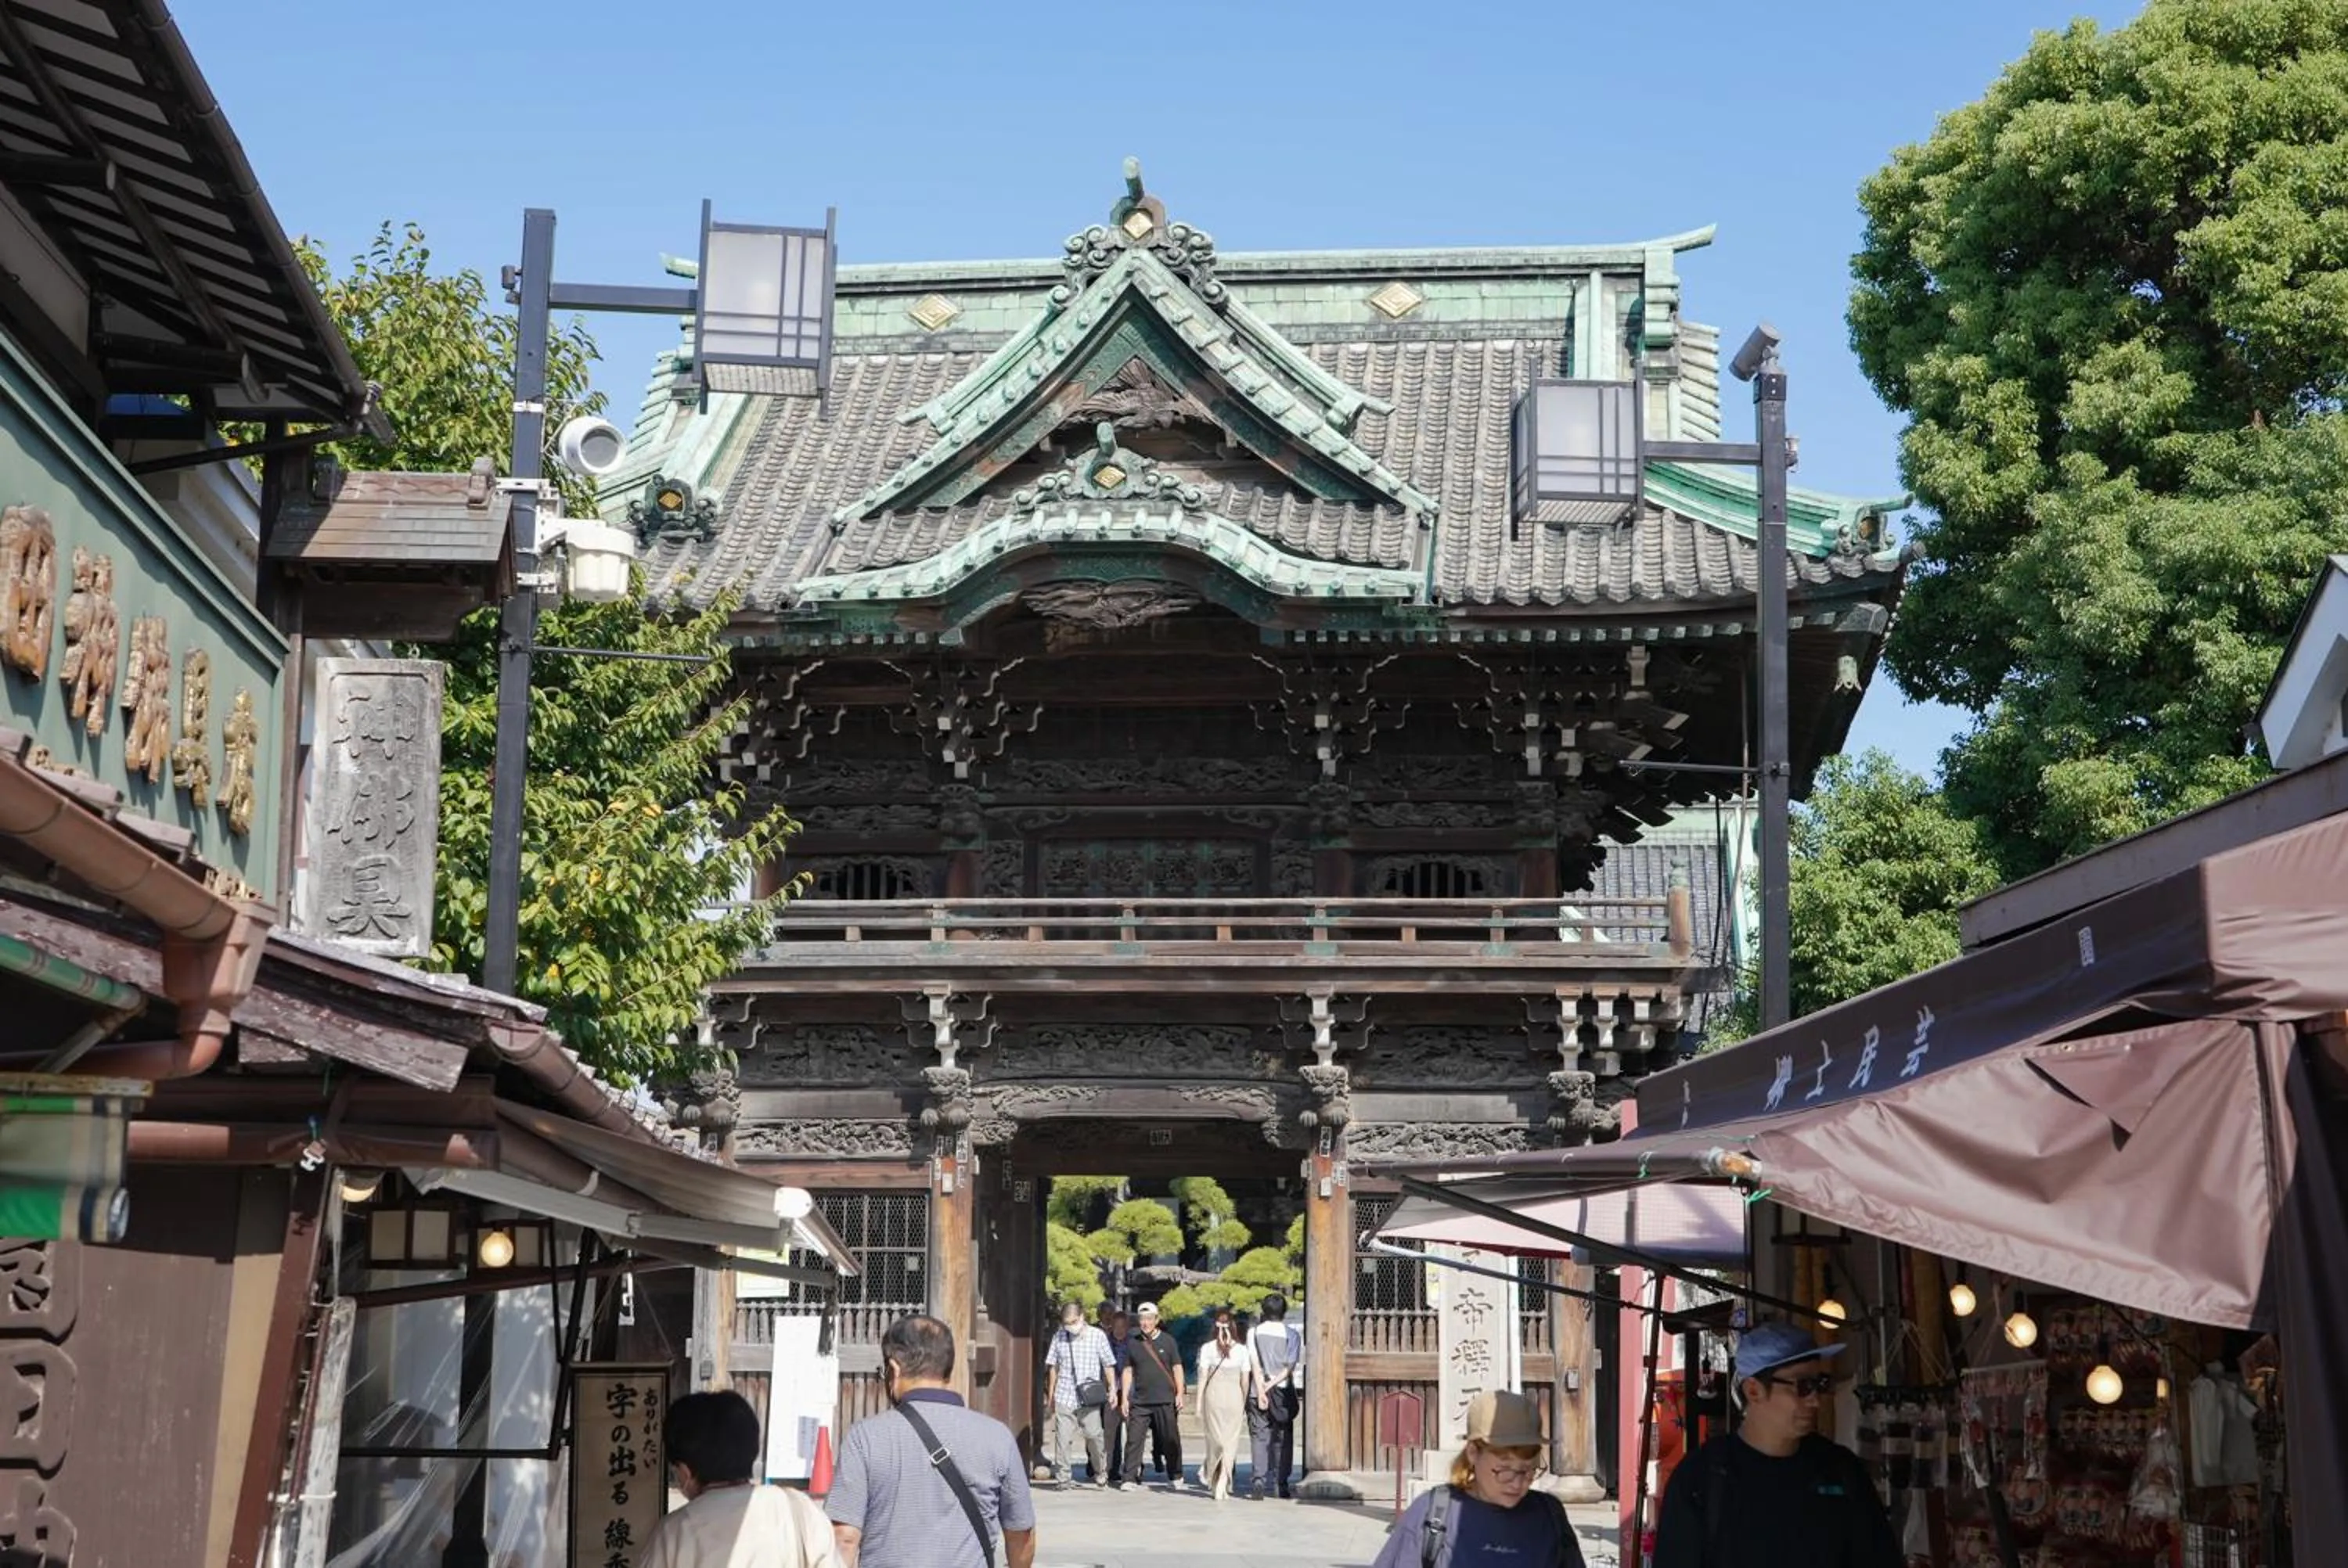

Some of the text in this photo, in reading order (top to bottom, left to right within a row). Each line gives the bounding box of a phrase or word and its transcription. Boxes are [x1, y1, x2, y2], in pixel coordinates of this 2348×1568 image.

[643, 1388, 657, 1469] ありがたい
